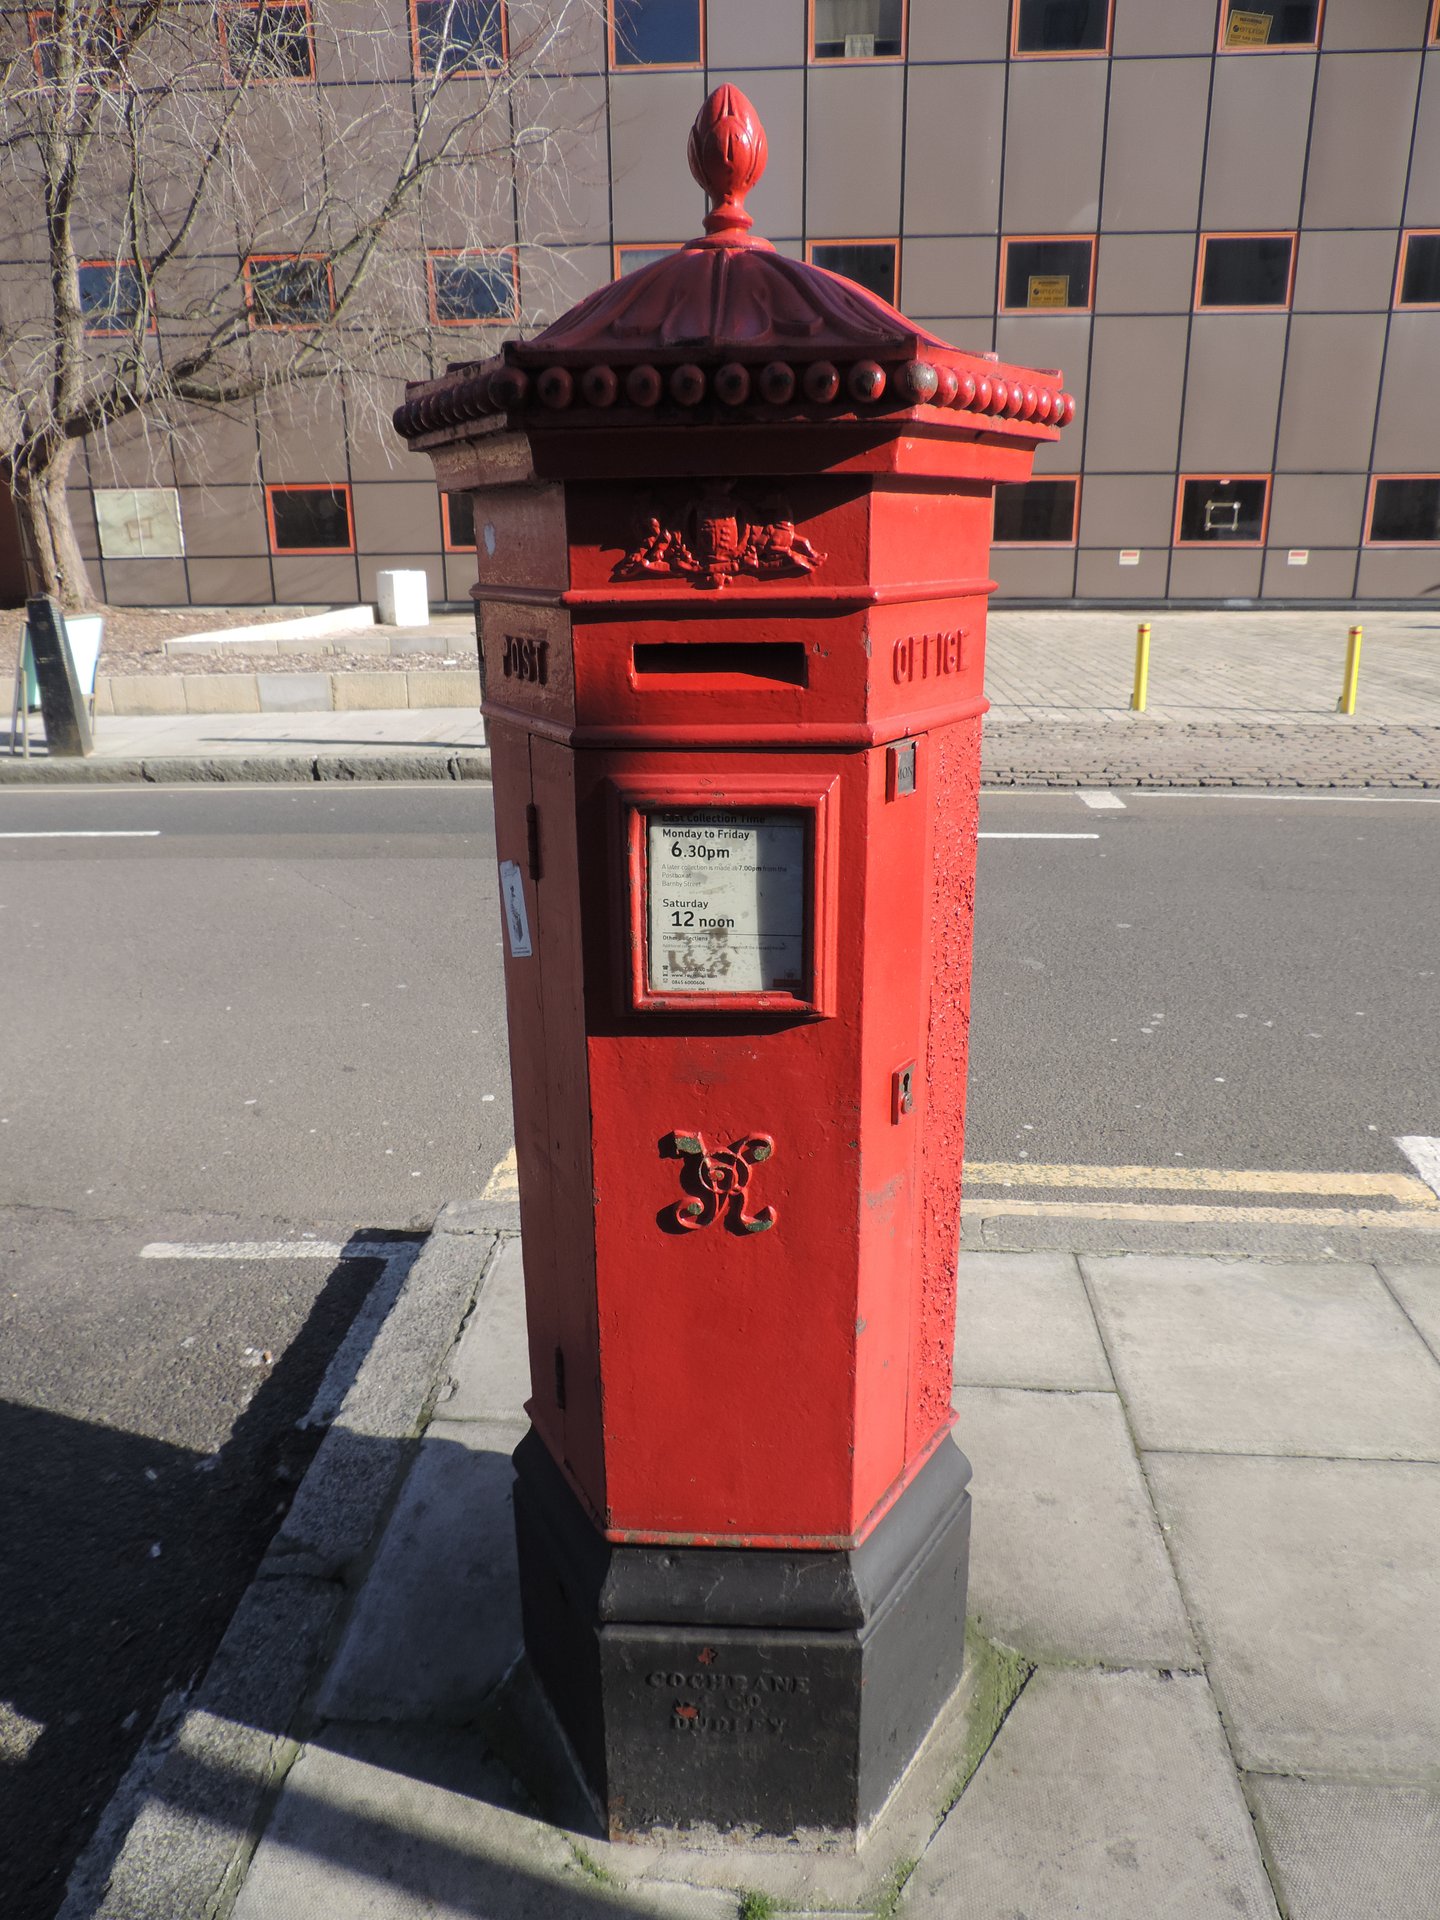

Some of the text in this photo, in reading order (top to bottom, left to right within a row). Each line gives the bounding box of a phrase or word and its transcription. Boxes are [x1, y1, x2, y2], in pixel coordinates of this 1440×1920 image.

[502, 634, 549, 687] POST
[893, 630, 970, 685] OFFICE
[687, 813, 737, 824] Collection
[662, 828, 750, 841] Monday to Friday
[671, 841, 730, 861] 6.30pm
[661, 871, 685, 879] Postbox
[662, 898, 709, 910] Saturday
[671, 910, 735, 928] 12 noon
[646, 1671, 811, 1695] COCHRANE
